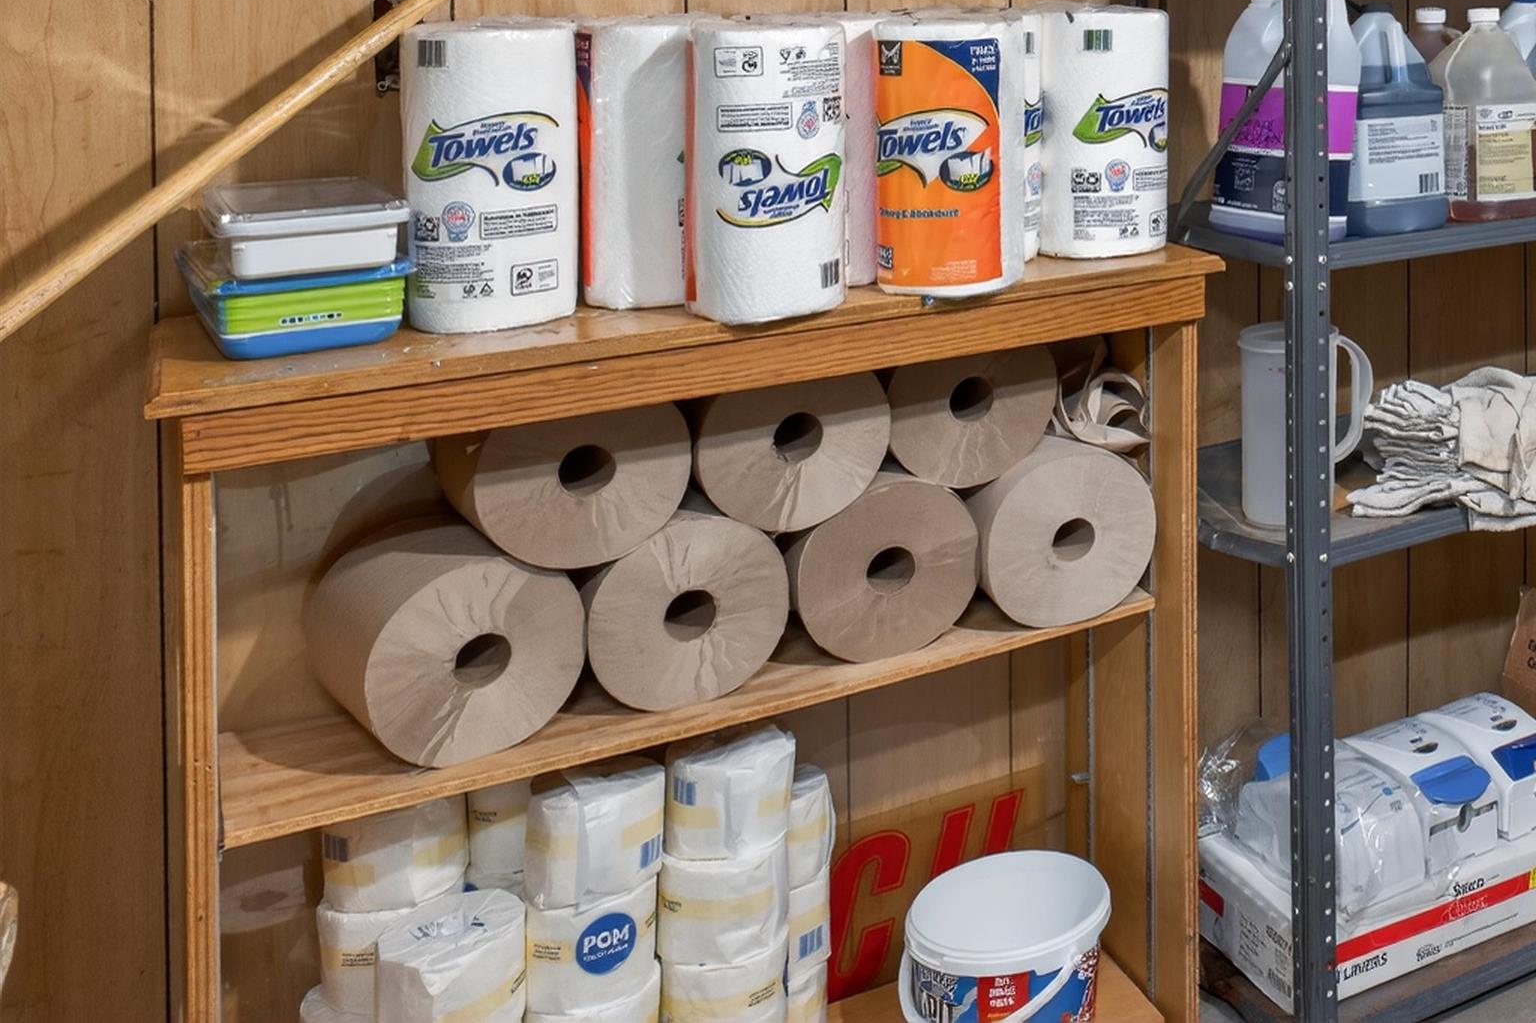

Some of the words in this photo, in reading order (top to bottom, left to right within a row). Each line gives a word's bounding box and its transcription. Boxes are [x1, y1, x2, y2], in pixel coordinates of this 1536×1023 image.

[429, 122, 538, 168] Towels
[738, 168, 829, 217] Towels
[583, 924, 629, 953] POM
